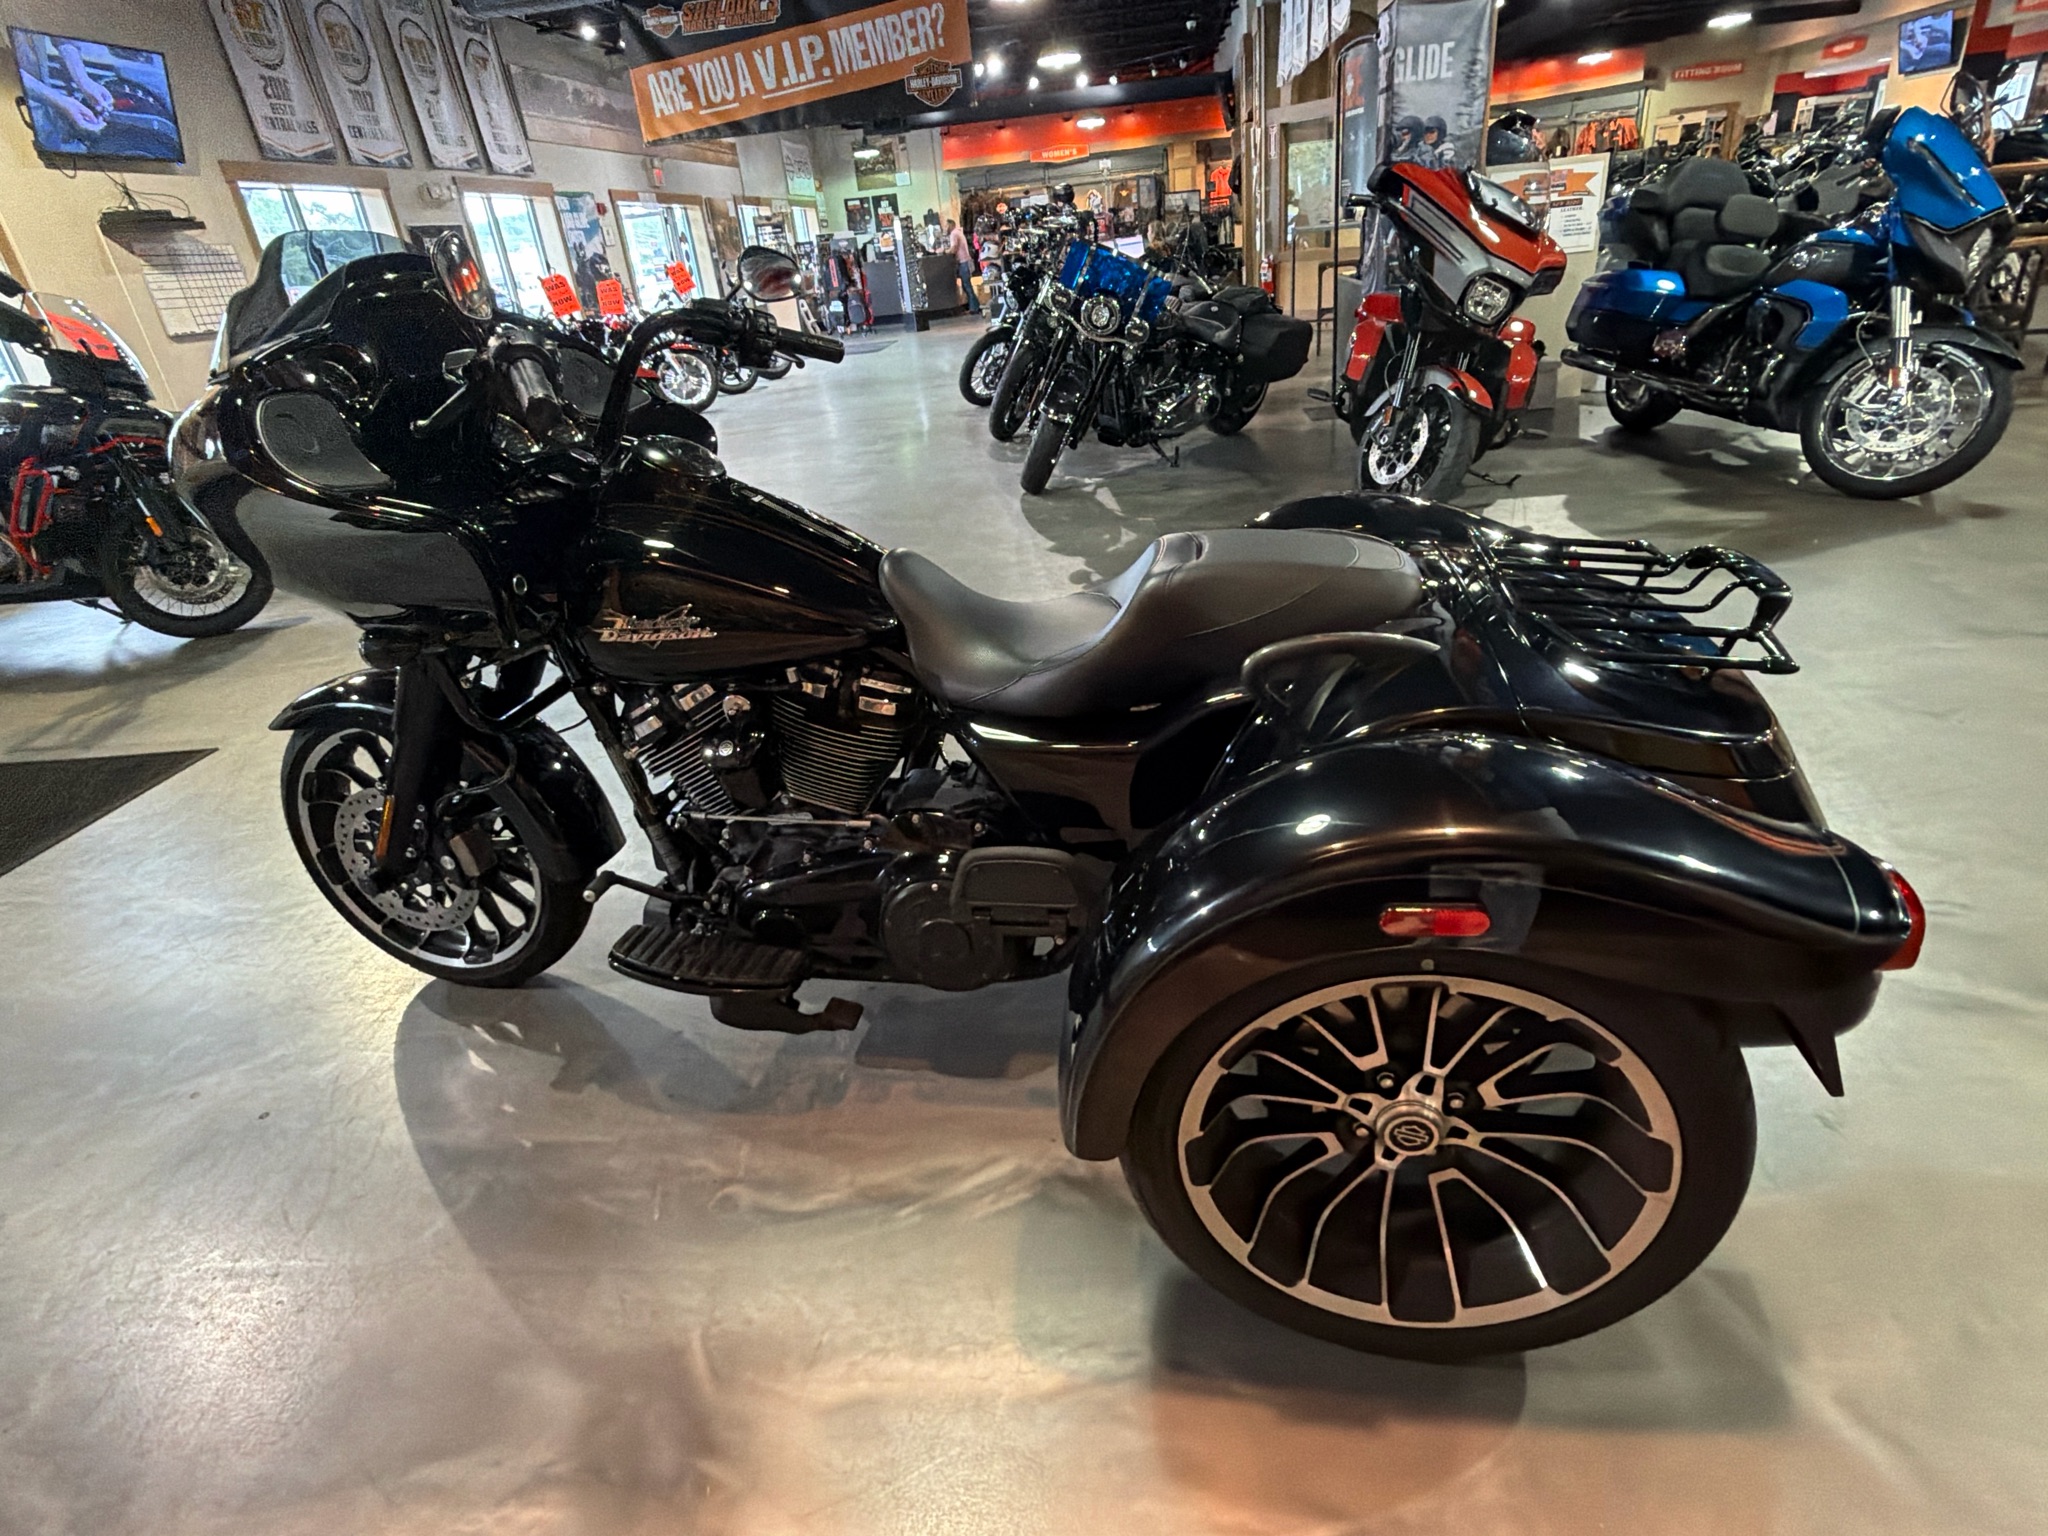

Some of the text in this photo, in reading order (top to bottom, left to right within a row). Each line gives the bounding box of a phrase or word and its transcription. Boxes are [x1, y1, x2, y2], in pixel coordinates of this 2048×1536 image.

[647, 2, 945, 118] ARE YOU A V.I.P. MEMBER?
[1394, 41, 1456, 84] GLIDE
[1041, 147, 1077, 159] WOMEN'S
[544, 281, 566, 293] WAS
[600, 286, 618, 294] WAS
[552, 296, 573, 308] NOW
[601, 299, 620, 307] NOW
